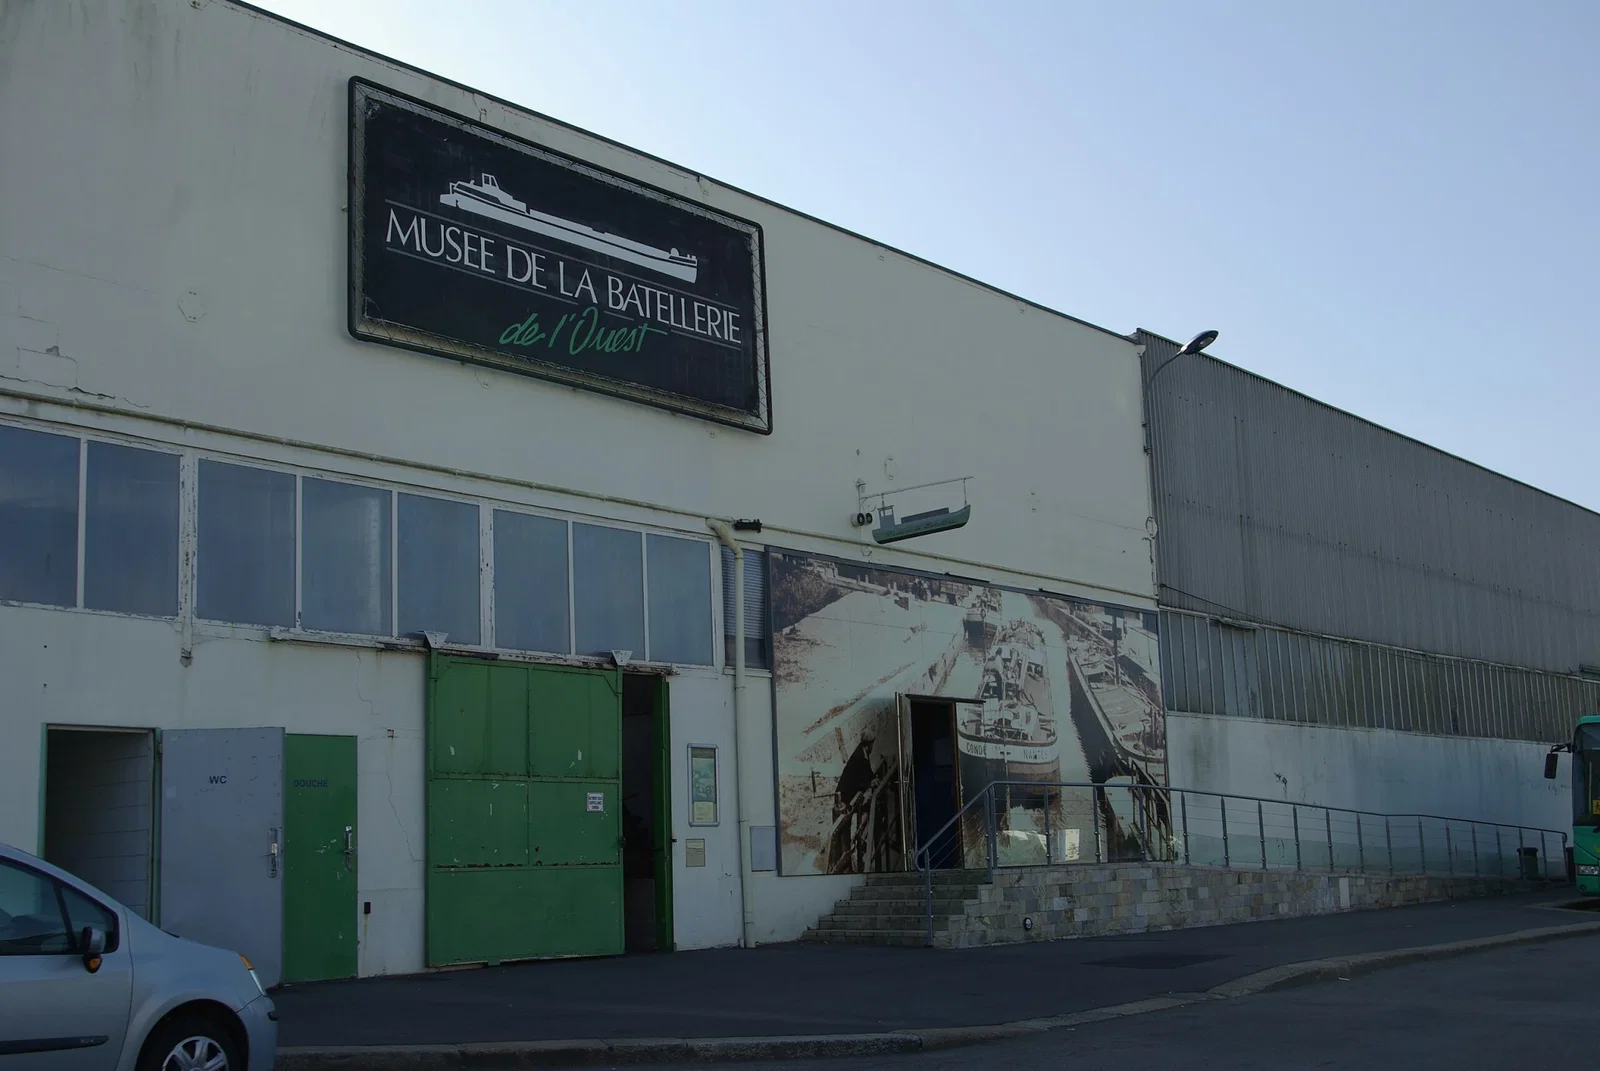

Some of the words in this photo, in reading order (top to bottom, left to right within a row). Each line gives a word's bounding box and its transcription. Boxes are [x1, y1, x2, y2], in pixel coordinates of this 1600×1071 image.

[386, 208, 495, 273] MUSEE
[506, 244, 547, 289] DE
[558, 261, 598, 303] LA
[607, 275, 742, 344] BATELLERIE
[499, 312, 546, 347] de
[548, 306, 668, 355] l'Ouest
[209, 775, 227, 784] WC
[293, 779, 329, 788] DOUCHE
